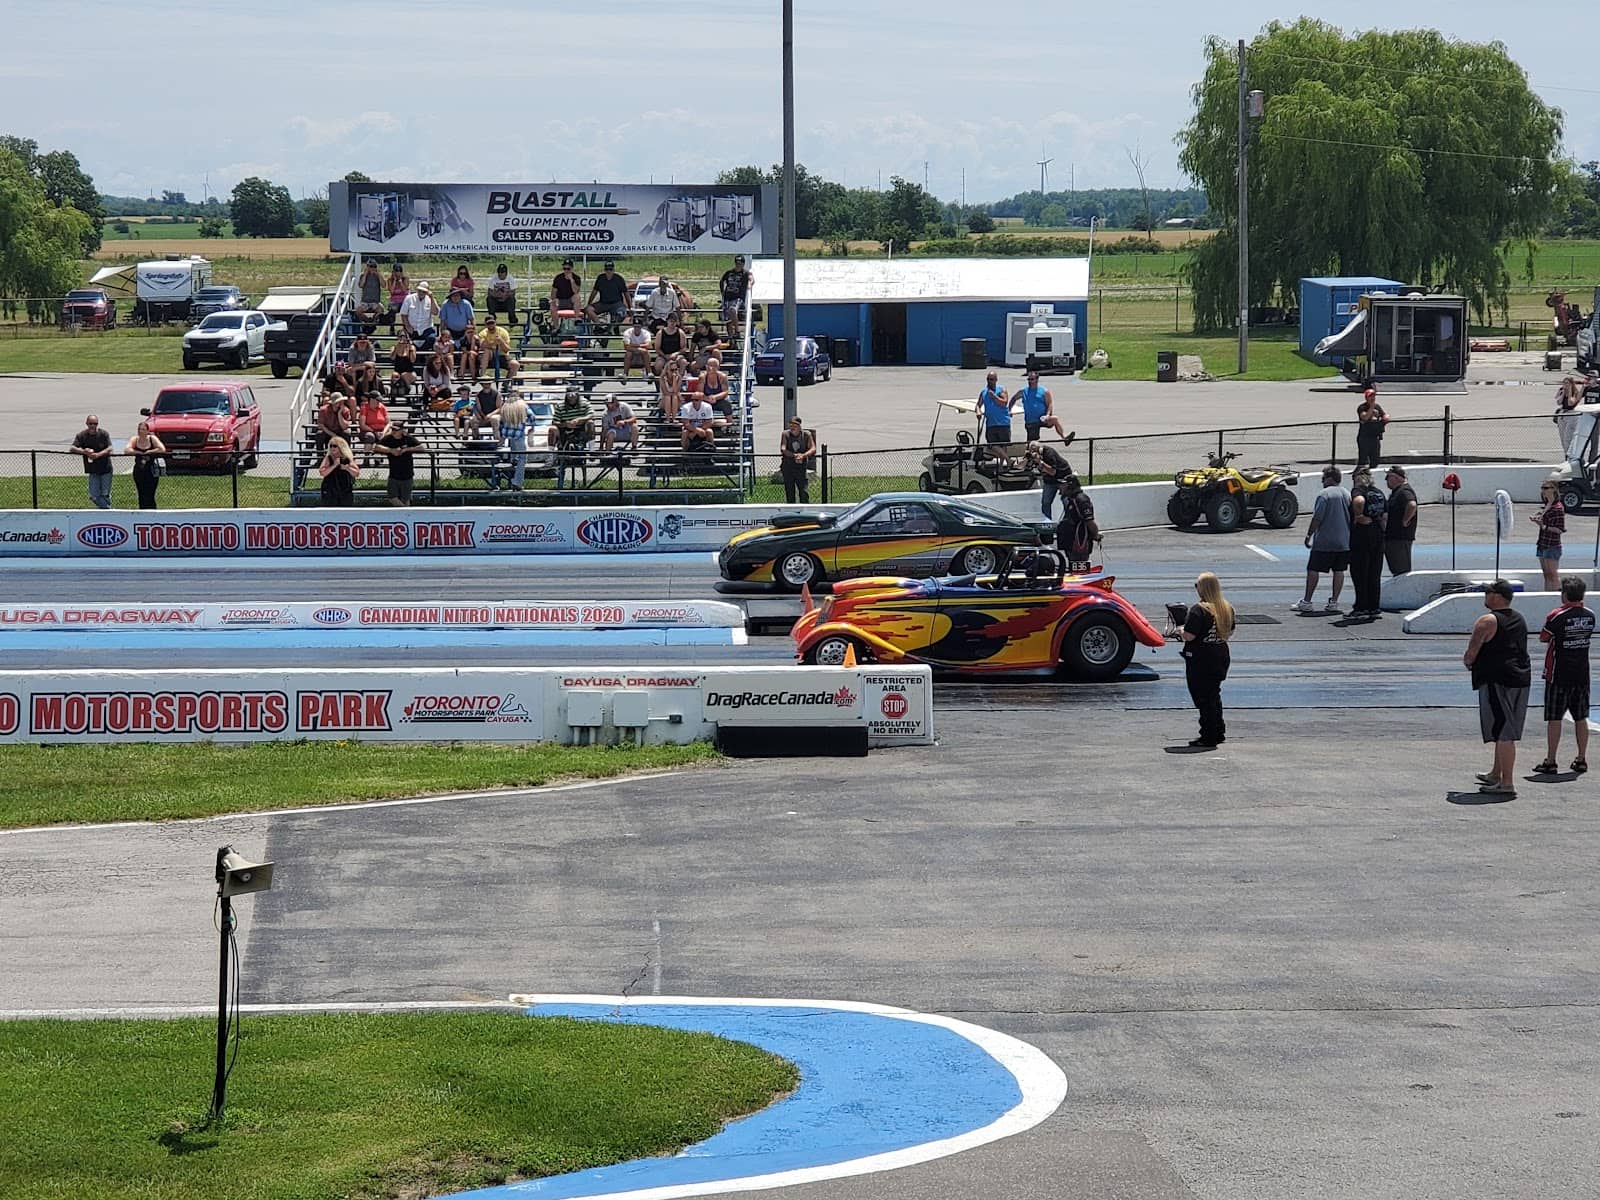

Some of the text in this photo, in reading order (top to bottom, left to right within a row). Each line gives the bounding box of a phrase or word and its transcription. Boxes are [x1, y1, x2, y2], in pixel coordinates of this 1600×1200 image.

[486, 191, 618, 215] BLASTALL
[503, 217, 608, 228] EQUIPMENT.COM
[497, 231, 610, 241] SALES AND RENTALS
[589, 511, 642, 522] CHAMPIONSHIP
[488, 524, 545, 534] TORONTO
[588, 519, 643, 544] NHRA
[84, 527, 122, 544] NHRA
[135, 521, 475, 550] TORONTO MOTORSPORTS PARK
[589, 540, 641, 550] DRAG RACING
[63, 609, 201, 623] DRAGWAY
[228, 609, 281, 618] TORONTO
[317, 609, 348, 623] NHRA
[360, 606, 625, 625] CANADIAN NITRO NATIONALS 2020
[637, 608, 686, 617] TORONTO
[563, 678, 698, 687] CAYUGA DRAGWAY
[866, 677, 923, 685] RESTRICTED
[414, 696, 501, 710] TORONTO
[884, 699, 905, 713] STOP
[31, 691, 288, 734] MOTORSPORTS
[296, 690, 392, 732] PARK
[868, 720, 921, 728] ABSOLUTELY
